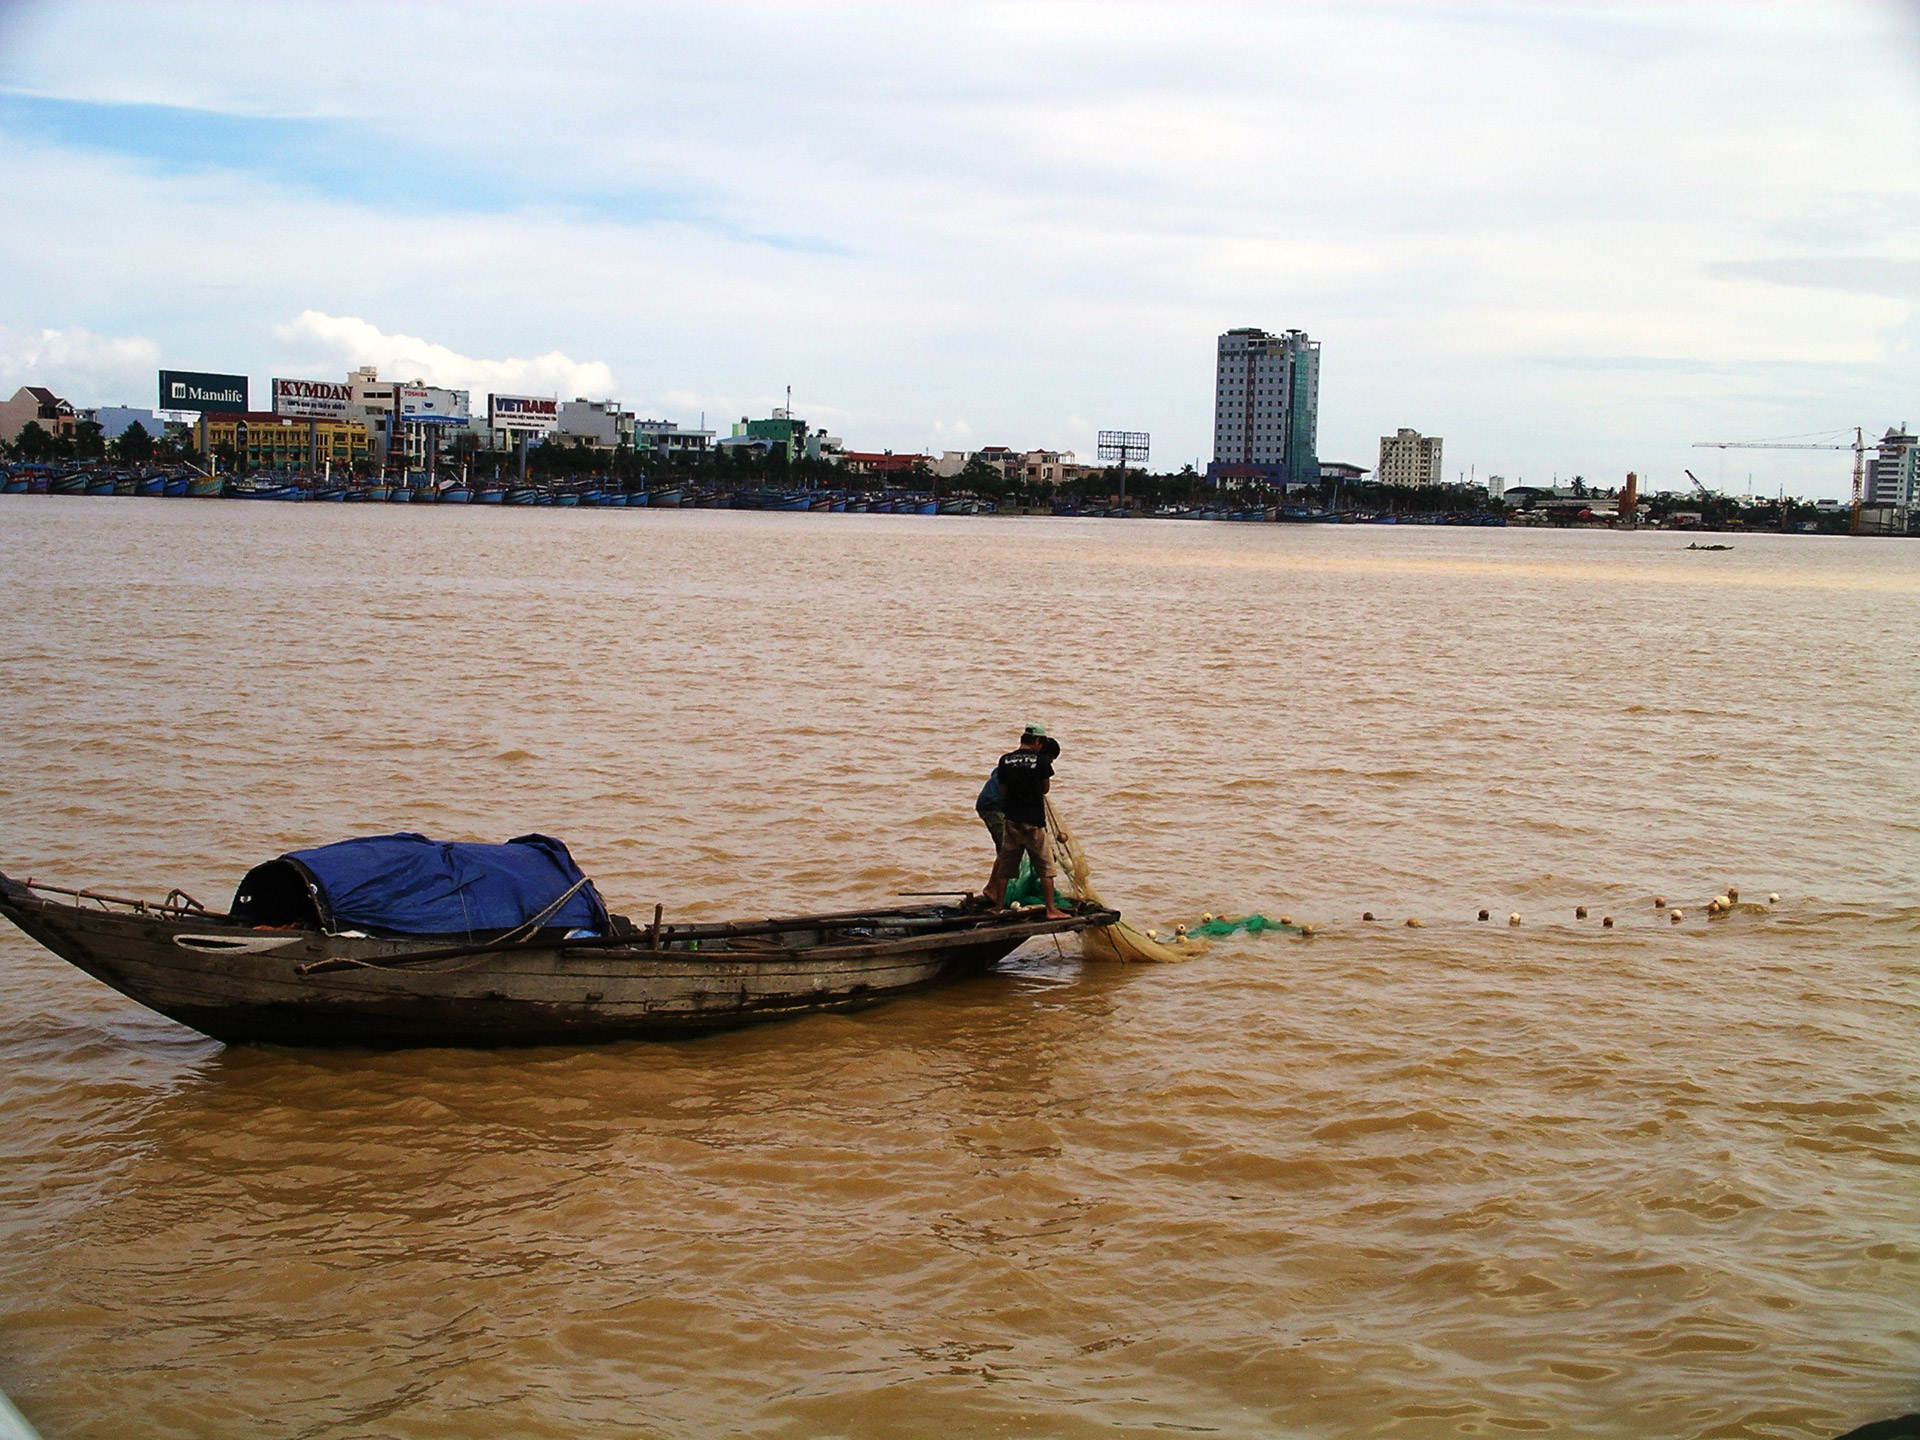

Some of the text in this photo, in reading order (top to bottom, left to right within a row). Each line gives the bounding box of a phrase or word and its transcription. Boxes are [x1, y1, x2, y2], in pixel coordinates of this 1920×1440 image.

[188, 386, 243, 403] Manulife
[279, 381, 353, 401] KYMDAN
[495, 398, 557, 415] VIETBANK
